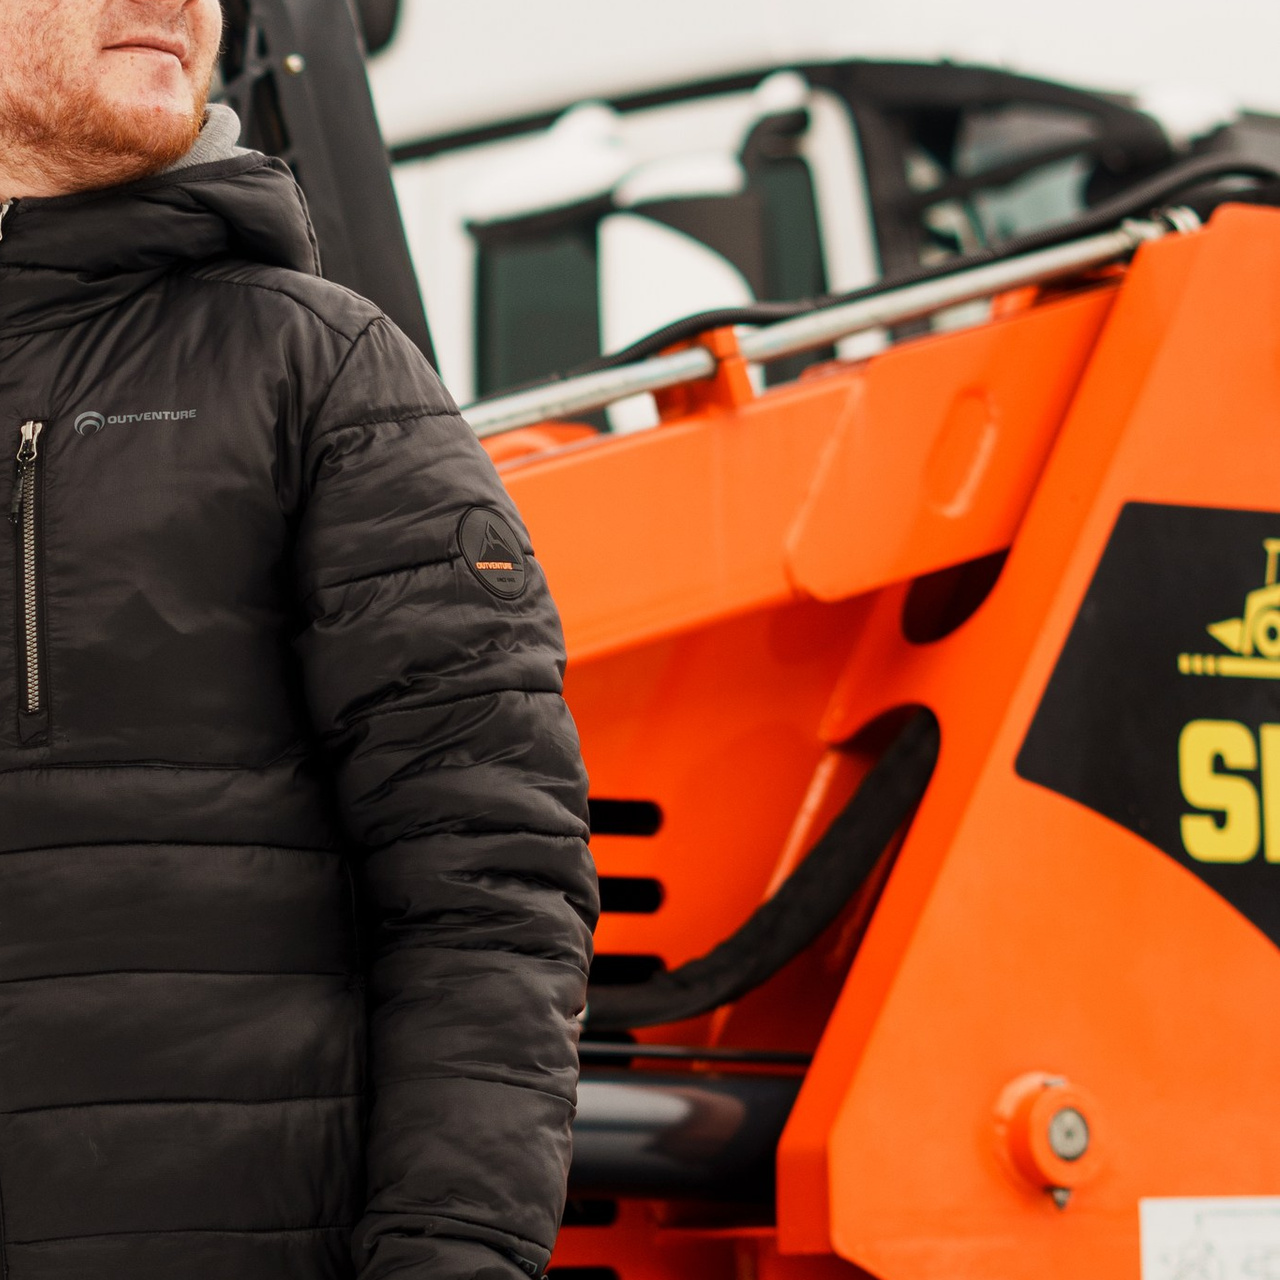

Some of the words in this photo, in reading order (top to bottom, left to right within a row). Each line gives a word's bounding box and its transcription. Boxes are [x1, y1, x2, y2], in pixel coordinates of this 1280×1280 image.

[107, 409, 197, 424] OUTVENTURE
[476, 562, 513, 570] OUTVENTURE
[1178, 719, 1280, 864] S
